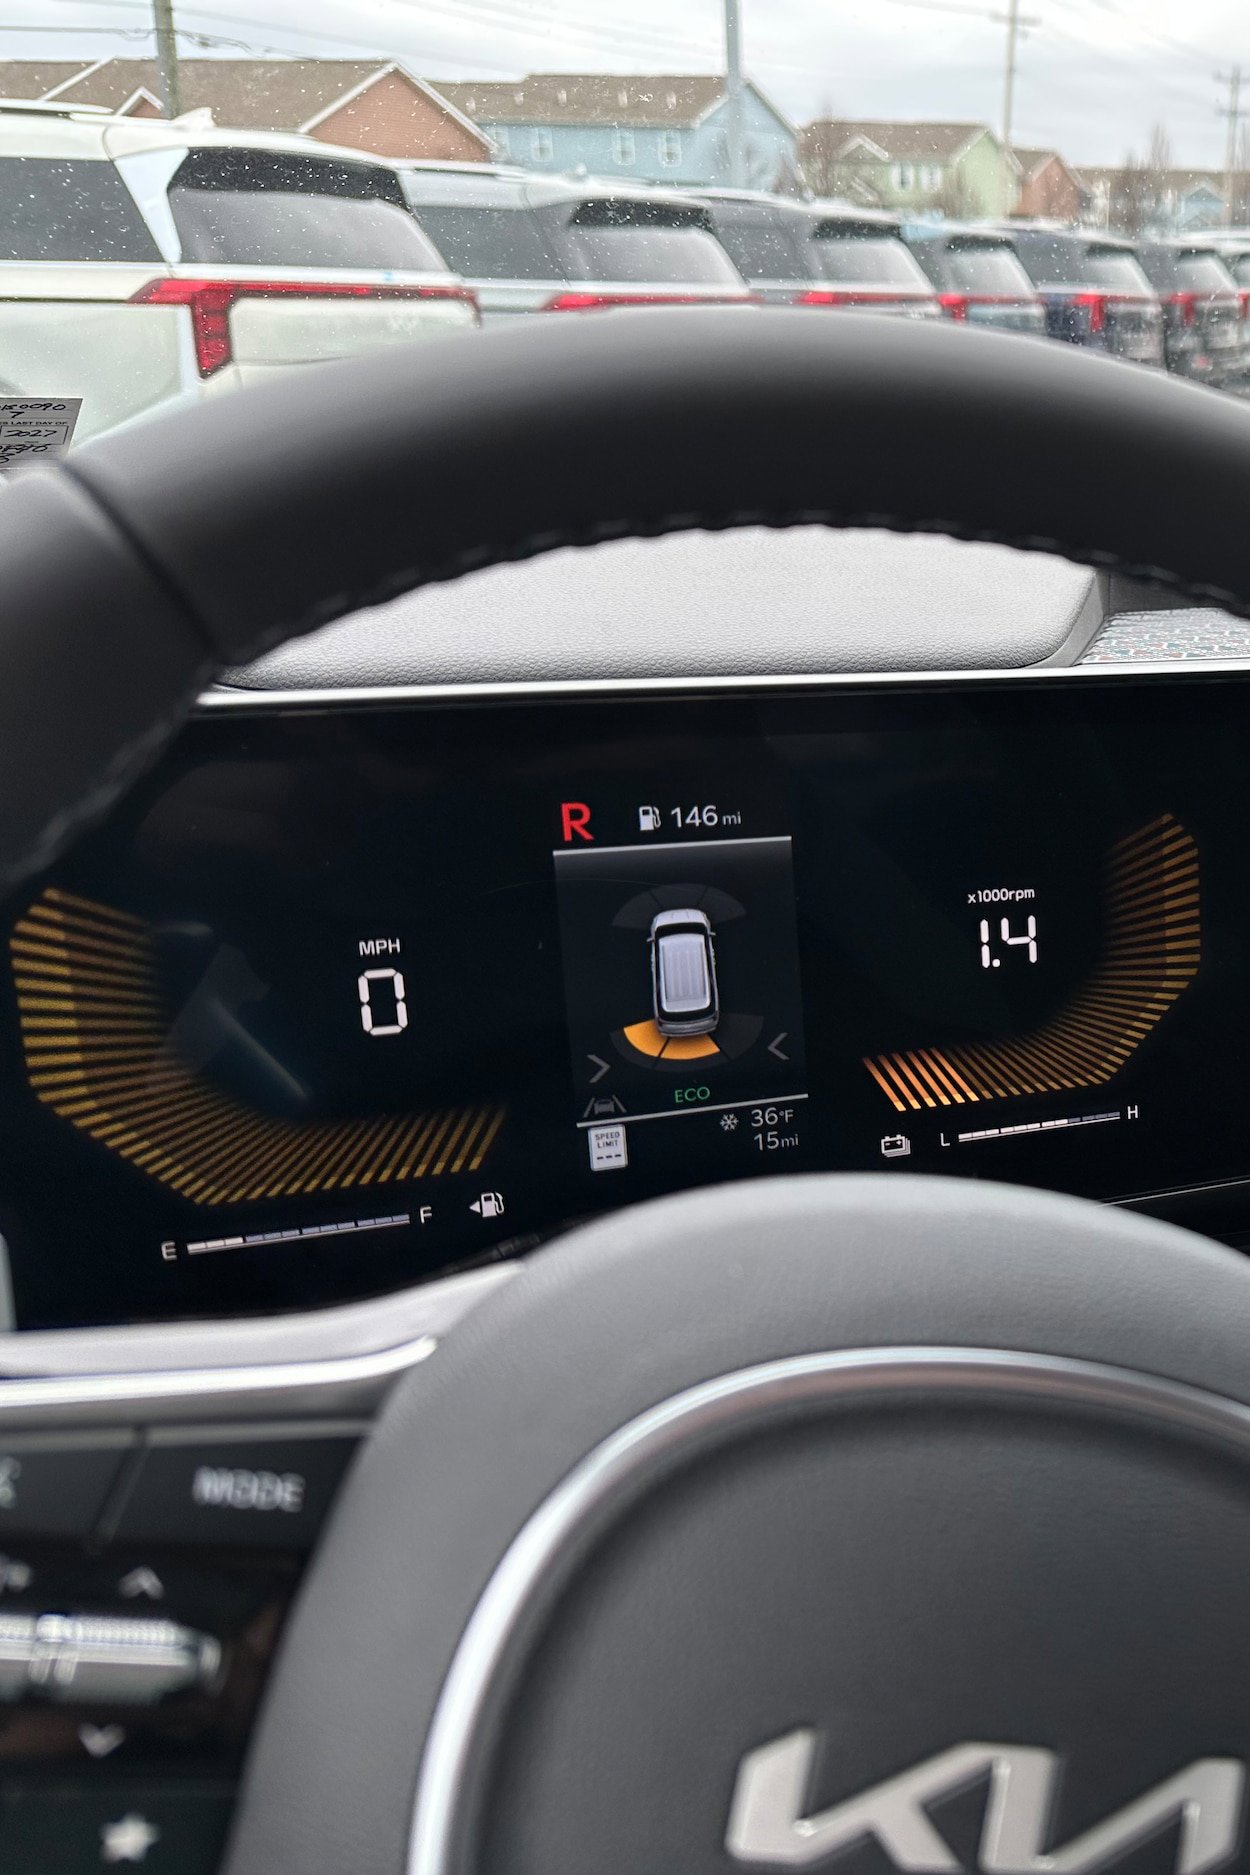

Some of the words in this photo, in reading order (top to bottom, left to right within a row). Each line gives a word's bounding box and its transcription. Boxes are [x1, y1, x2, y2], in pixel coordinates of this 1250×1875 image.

[4, 429, 58, 438] 2027
[561, 802, 595, 842] R
[671, 805, 719, 828] 146
[722, 811, 742, 826] mi
[967, 888, 1035, 904] x1000rpm
[359, 938, 401, 956] MPH
[980, 915, 1037, 968] 1.4
[358, 967, 408, 1036] 0
[674, 1086, 711, 1104] ECO
[1127, 1105, 1139, 1120] H
[594, 1131, 621, 1141] SPEED
[597, 1140, 620, 1149] LIMIT
[940, 1132, 951, 1147] L
[420, 1206, 433, 1224] F
[161, 1241, 178, 1261] E
[192, 1465, 306, 1513] MODE
